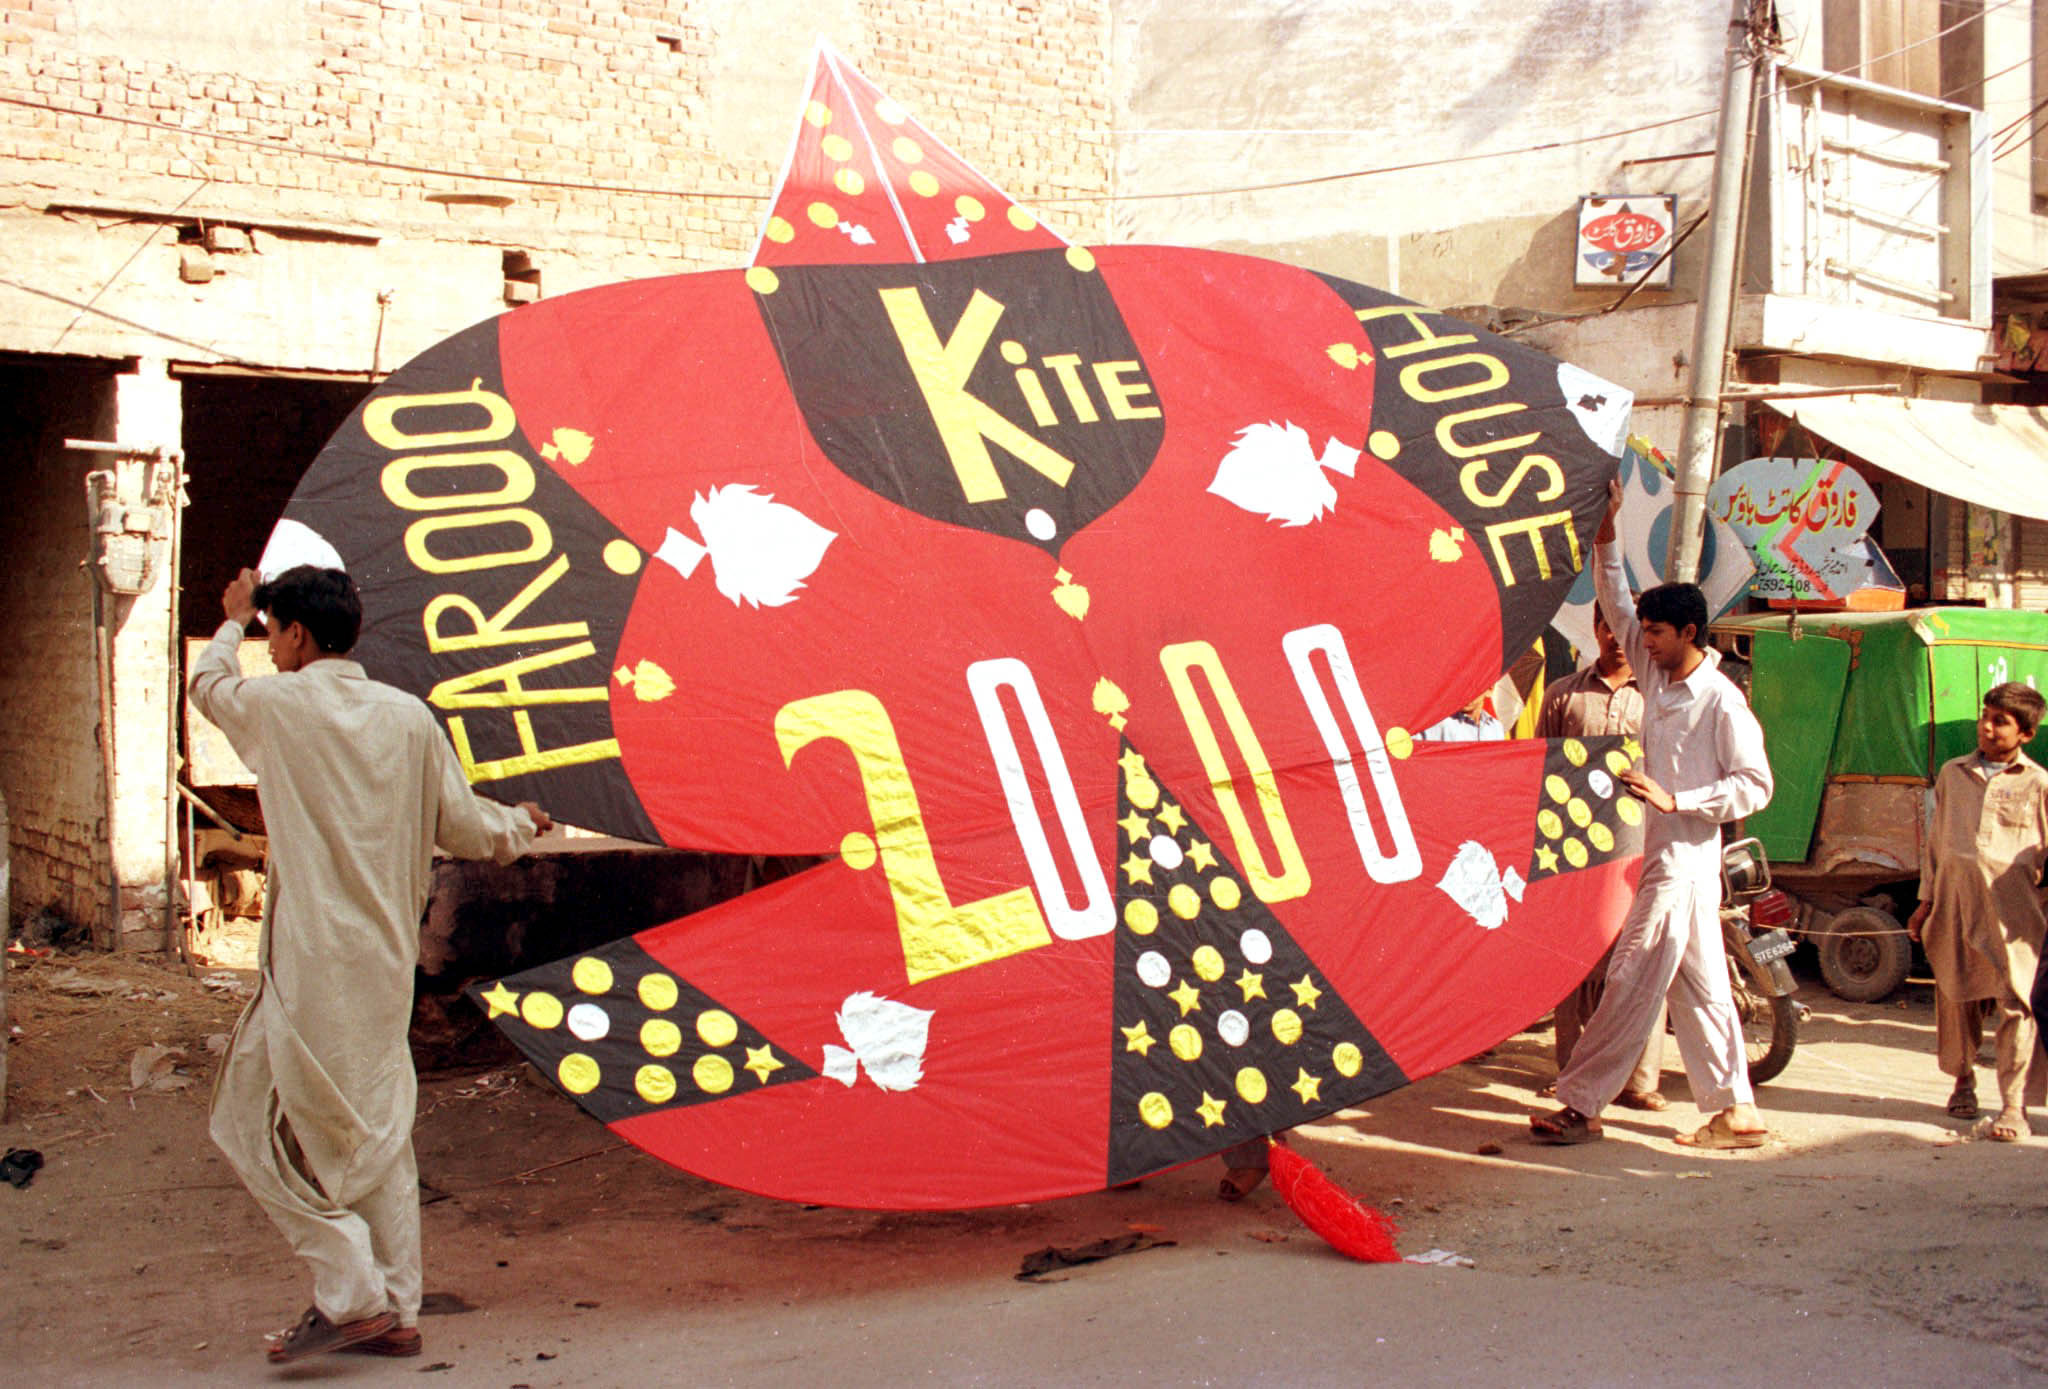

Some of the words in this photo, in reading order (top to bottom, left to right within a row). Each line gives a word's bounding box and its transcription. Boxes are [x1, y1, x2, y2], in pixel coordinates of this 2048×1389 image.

[362, 376, 622, 785] FAROOQ
[1354, 305, 1583, 587] HOUSE
[1806, 478, 1858, 533] فاروق
[774, 623, 1423, 986] 2000
